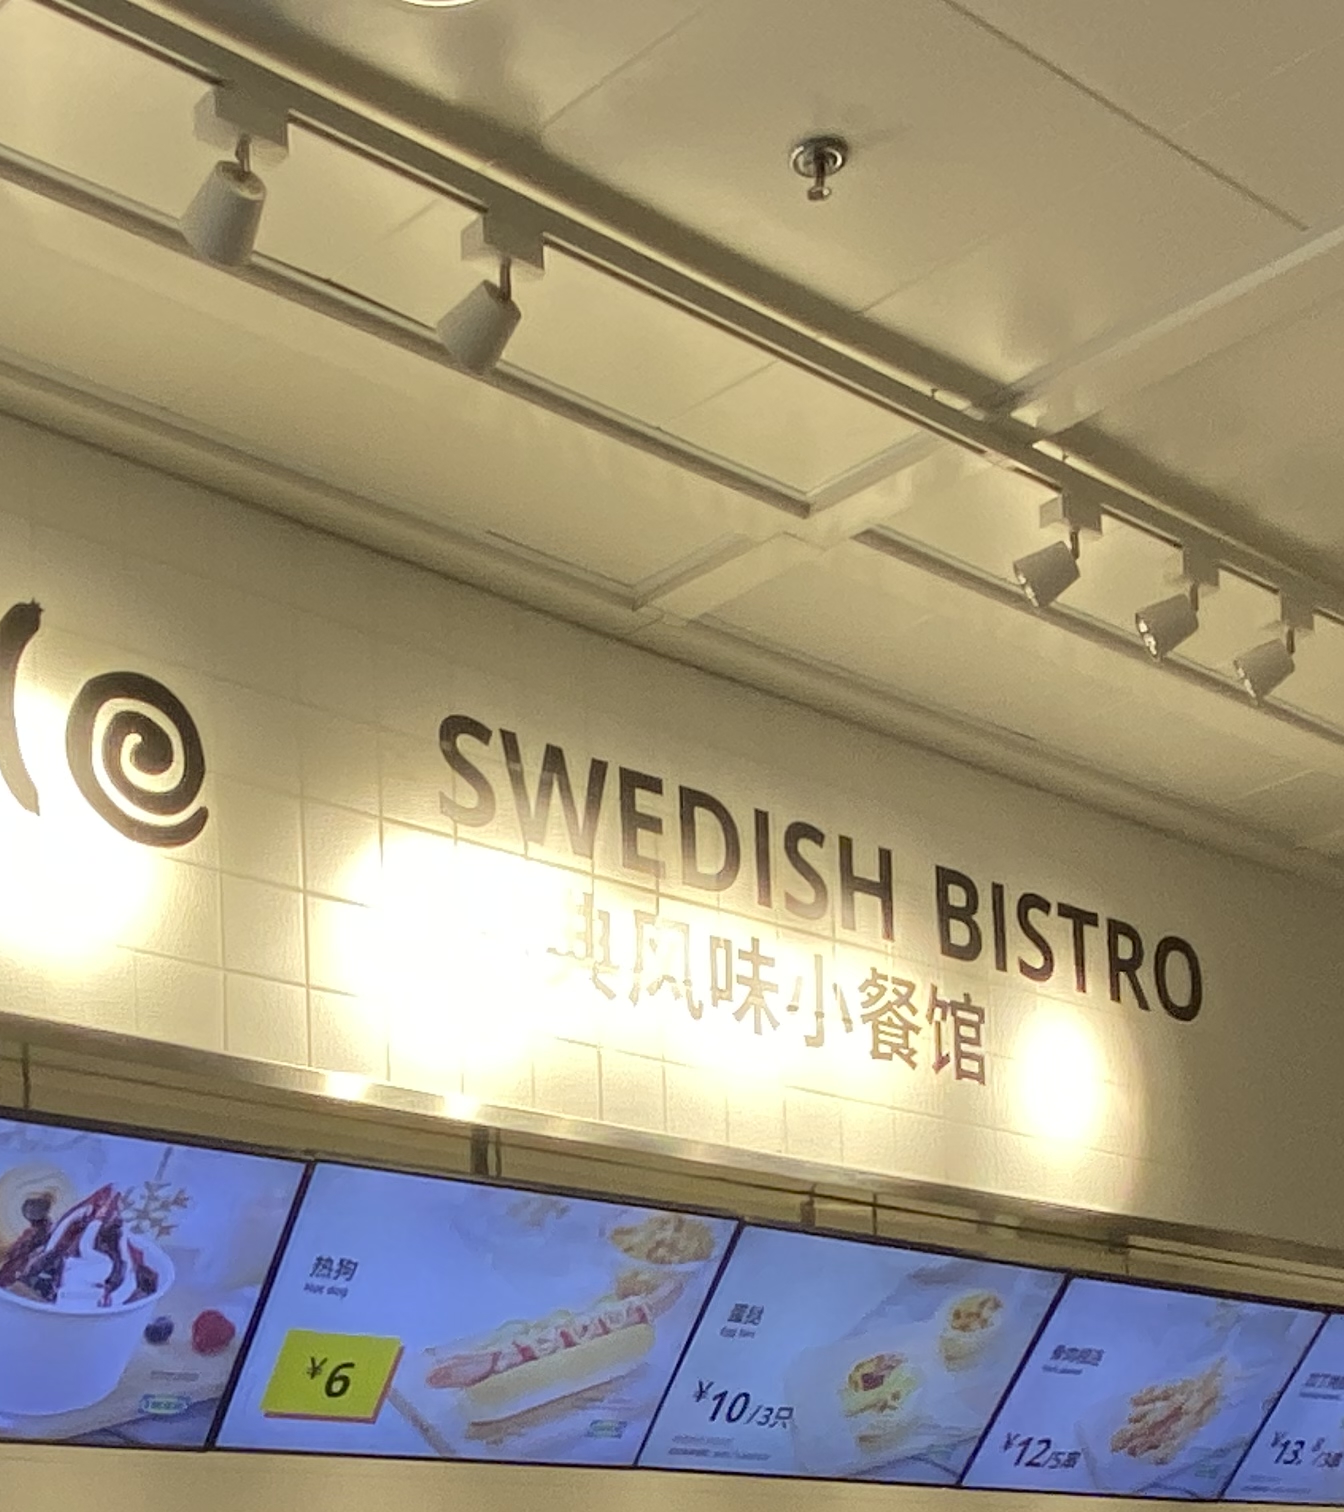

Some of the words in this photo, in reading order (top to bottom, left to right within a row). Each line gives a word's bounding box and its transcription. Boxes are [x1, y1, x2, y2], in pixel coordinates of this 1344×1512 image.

[438, 714, 895, 942] SWEDISH
[934, 864, 1203, 1023] BISTRO
[546, 890, 987, 1086] 典风味小餐馆
